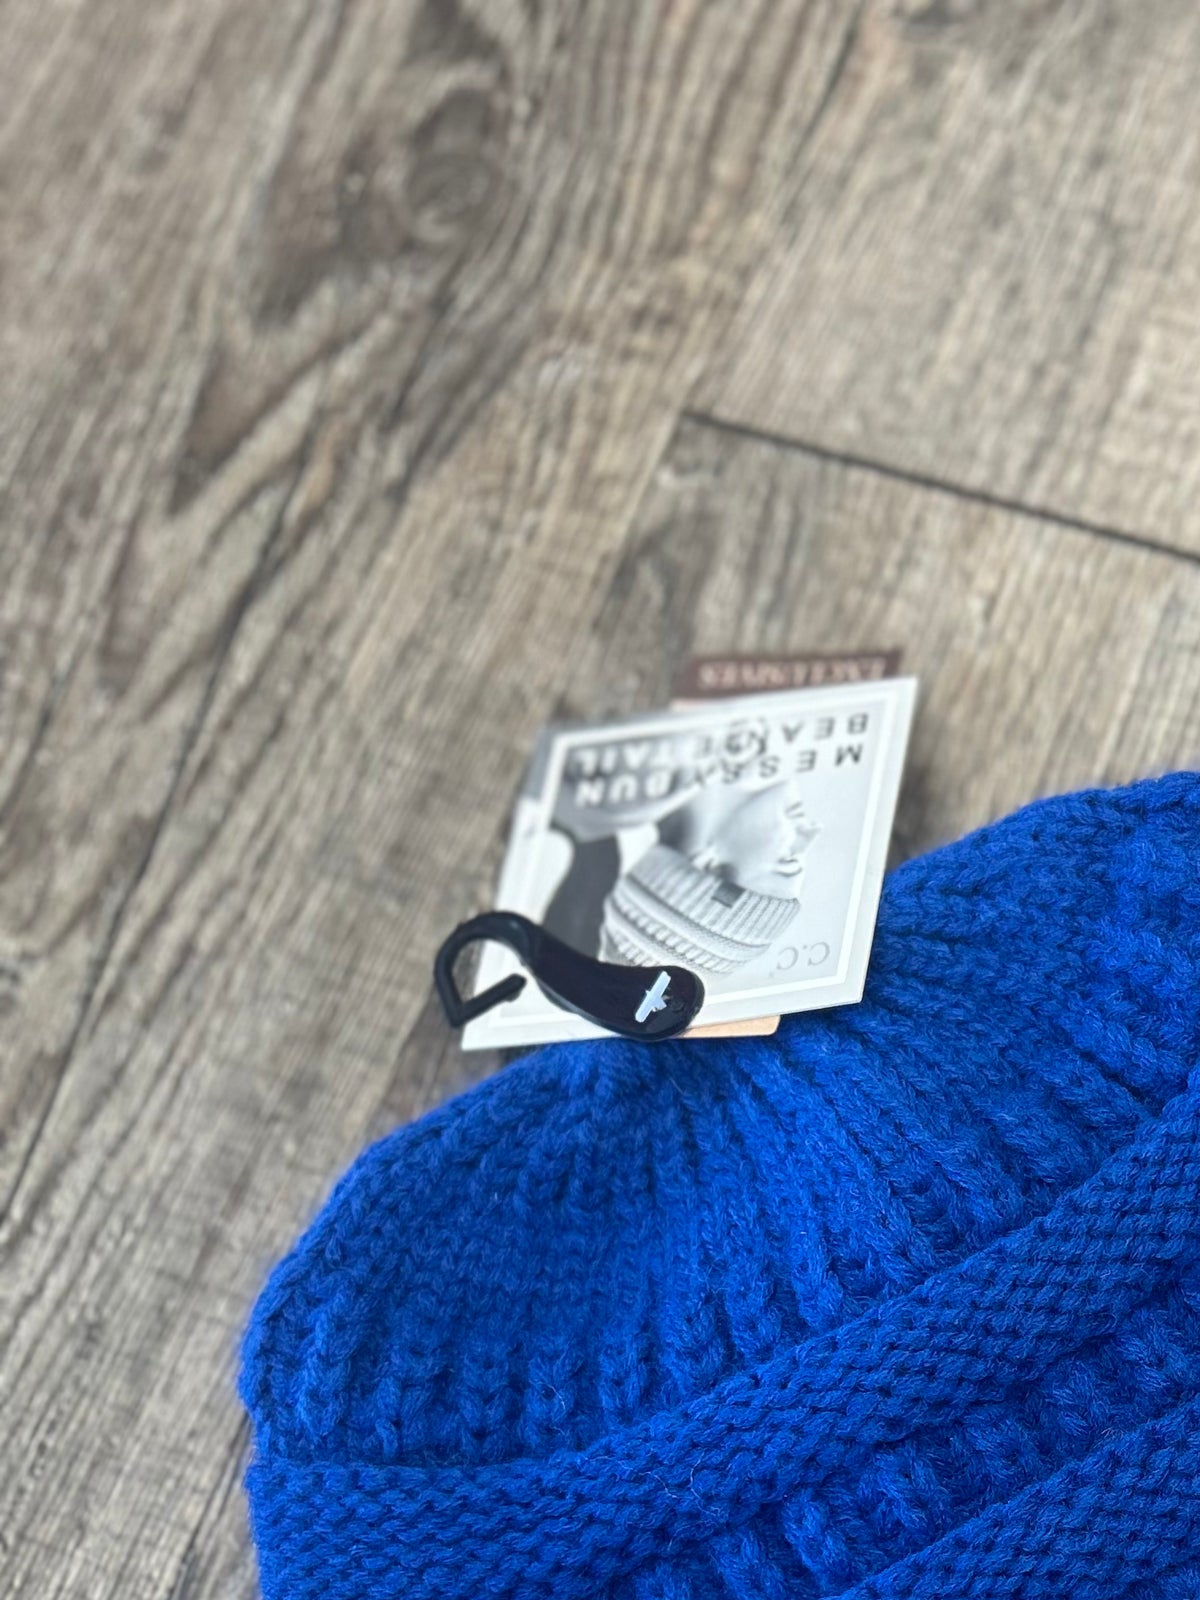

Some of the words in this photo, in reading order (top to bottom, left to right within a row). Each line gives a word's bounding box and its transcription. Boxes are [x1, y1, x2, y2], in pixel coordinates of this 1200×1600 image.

[571, 743, 676, 777] TAIL
[690, 743, 864, 789] MESSY
[574, 768, 674, 808] BUN
[776, 941, 831, 970] C.C
